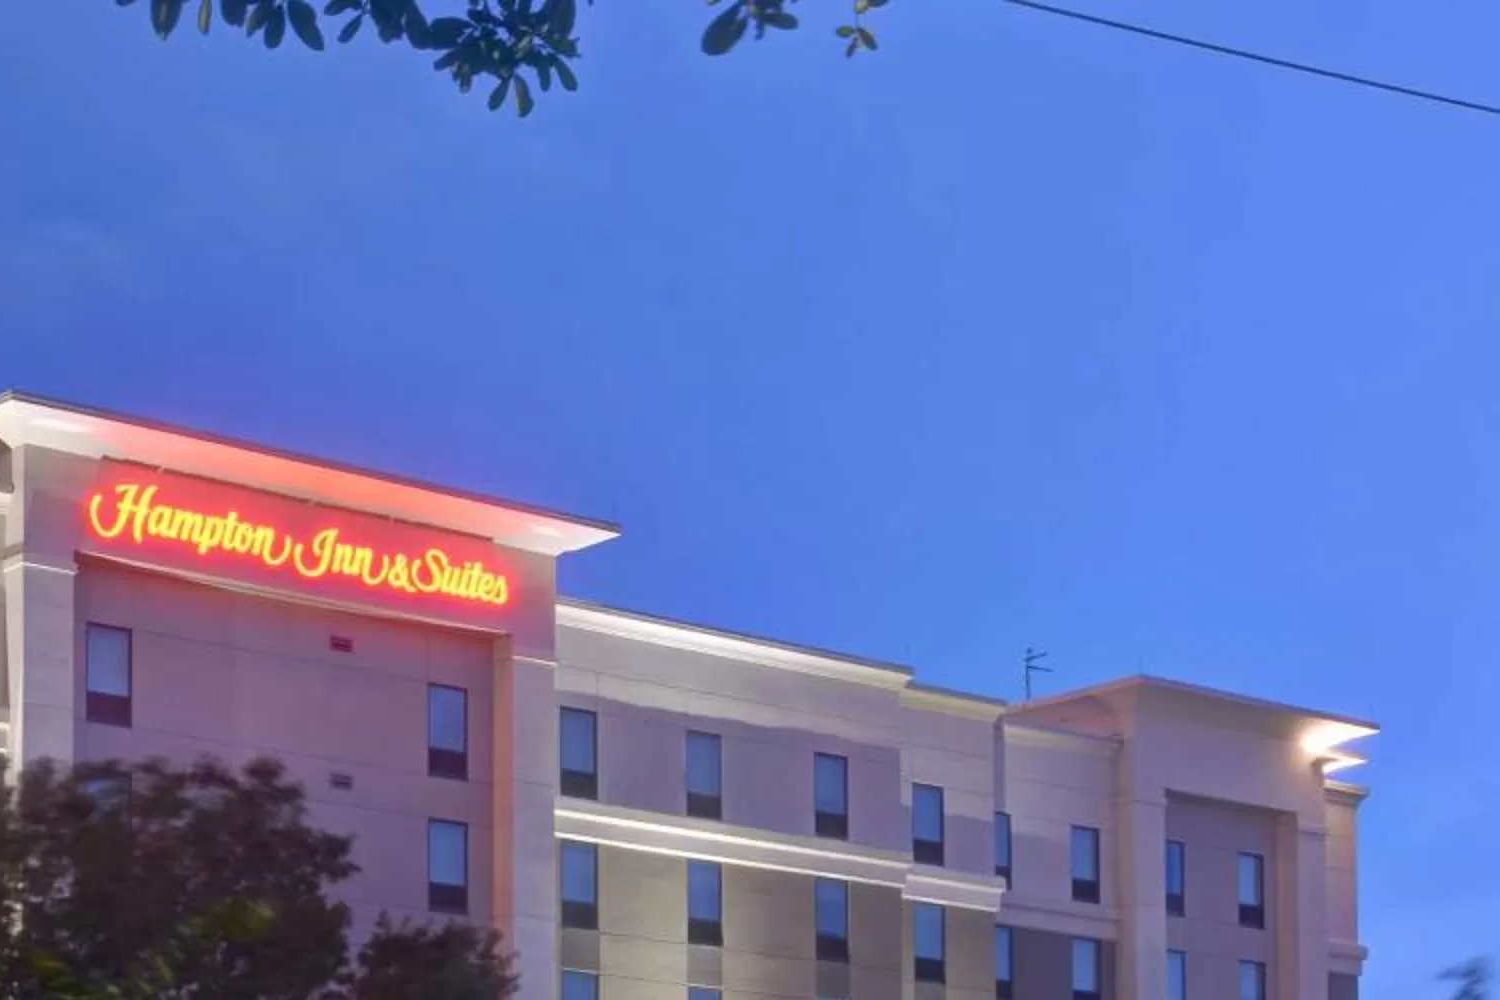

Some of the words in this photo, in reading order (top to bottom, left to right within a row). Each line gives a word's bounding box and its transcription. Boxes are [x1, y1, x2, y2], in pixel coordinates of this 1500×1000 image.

[90, 484, 293, 565] Hampton
[294, 529, 389, 584] Inn
[412, 549, 508, 604] Suites
